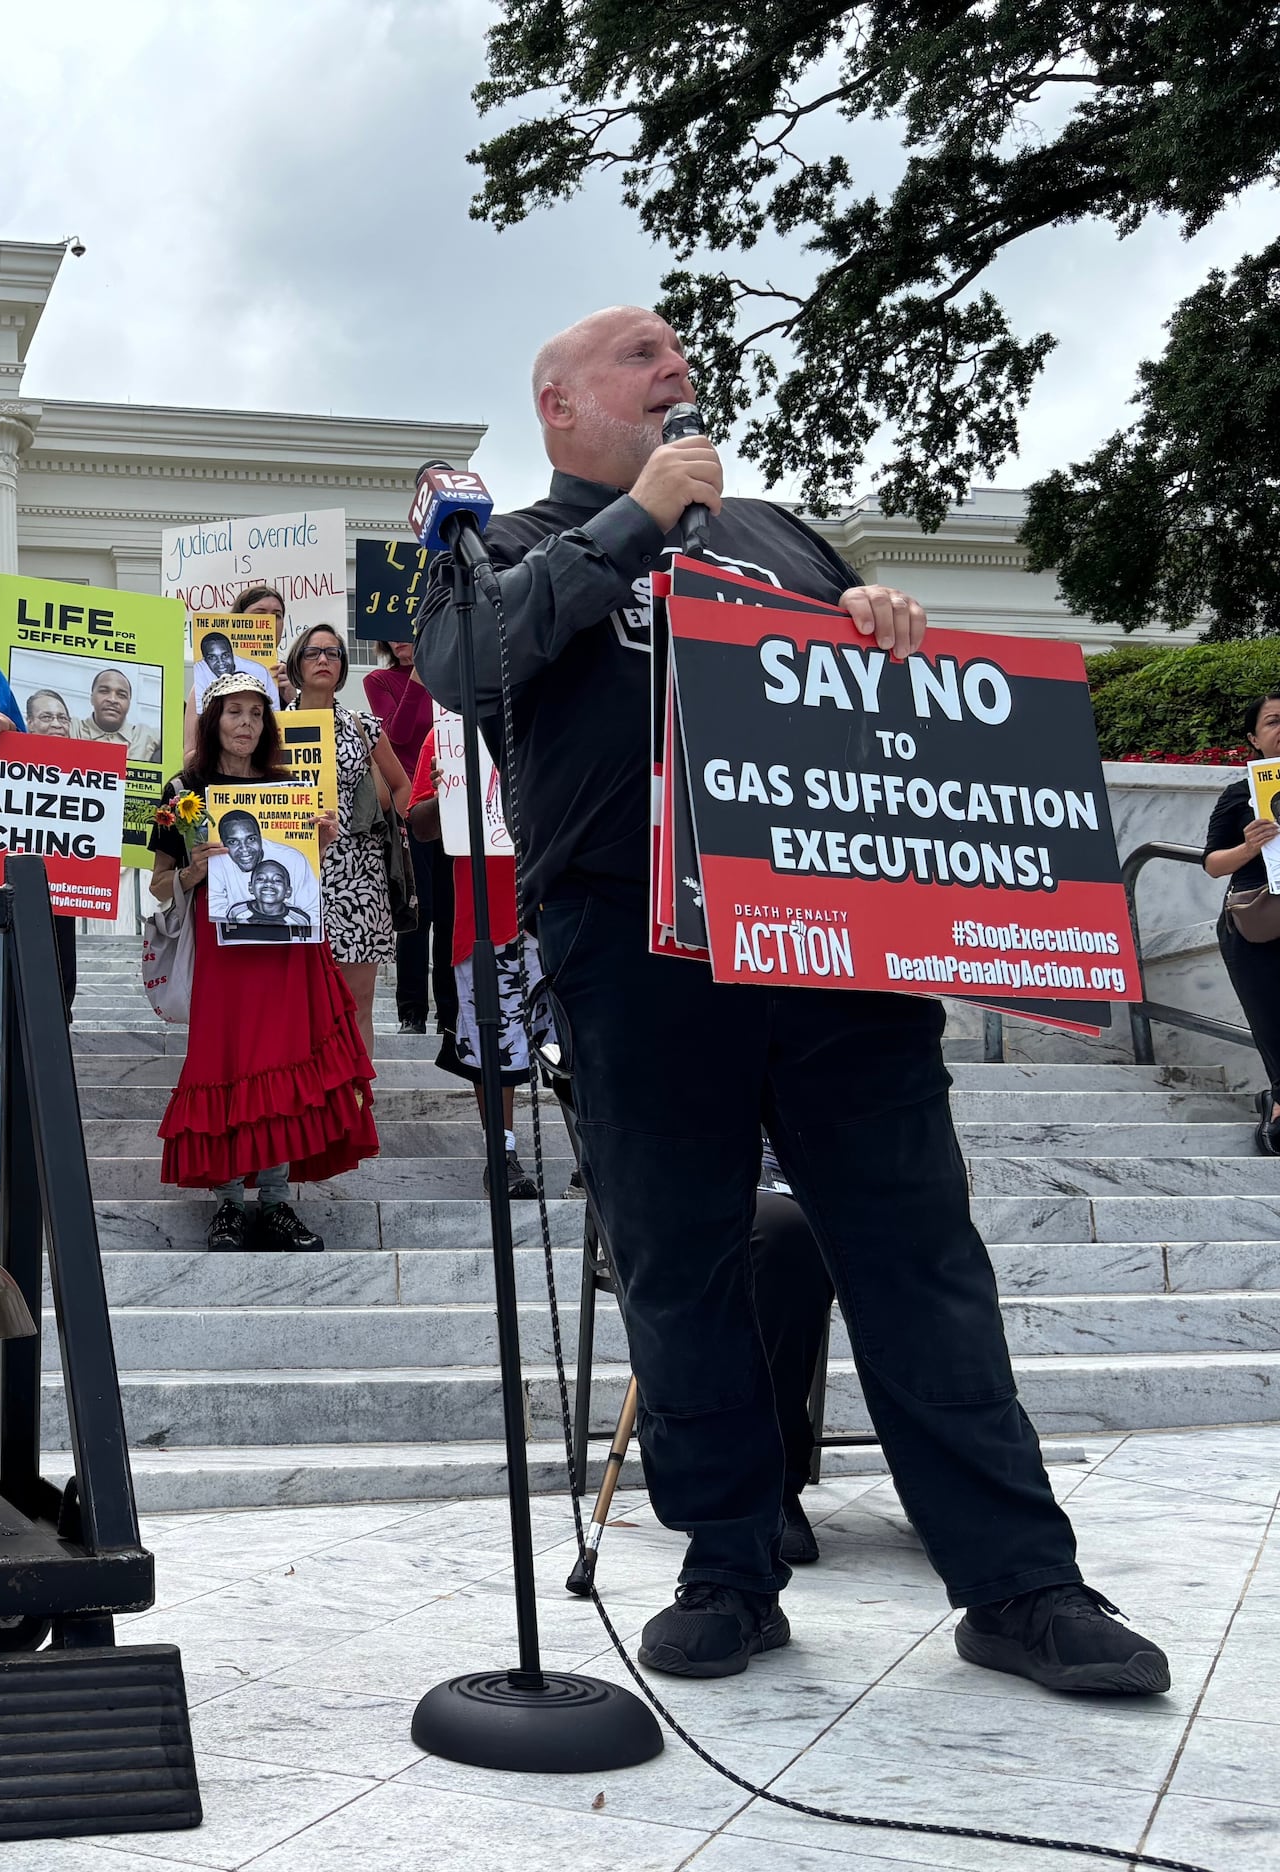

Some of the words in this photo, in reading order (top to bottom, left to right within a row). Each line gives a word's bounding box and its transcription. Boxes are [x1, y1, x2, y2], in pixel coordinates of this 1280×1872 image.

[435, 473, 482, 491] 12
[412, 481, 433, 525] 12
[441, 490, 489, 501] WSFA
[419, 499, 438, 540] WSFA
[166, 521, 233, 582] judicial
[248, 513, 319, 550] override
[17, 598, 114, 637] LIFE
[115, 631, 136, 640] FOR
[196, 618, 209, 628] THE
[211, 618, 230, 629] JURY
[231, 619, 254, 629] VOTED
[255, 619, 272, 630] LIFE.
[17, 628, 98, 650] JEFFERY
[104, 640, 137, 655] LEE
[230, 633, 256, 641] ALABAMA
[251, 649, 274, 657] ANYWAY.
[759, 639, 886, 713] SAY
[908, 655, 1013, 726] NO
[294, 747, 322, 764] FOR
[875, 730, 916, 761] TO
[66, 769, 118, 791] ARE
[1257, 770, 1273, 782] THE
[126, 782, 156, 792] THEM.
[703, 758, 794, 807] GAS
[803, 768, 1099, 832] SUFFOCATION
[213, 793, 230, 804] THE
[232, 793, 257, 805] JURY
[259, 793, 289, 805] VOTED
[291, 794, 313, 806] LIFE.
[258, 811, 292, 820] ALABAMA
[293, 812, 315, 820] PLANS
[260, 822, 269, 830] TO
[270, 821, 300, 830] EXECUTE
[301, 821, 315, 830] HIM
[284, 831, 316, 841] ANYWAY.
[770, 826, 1054, 888] EXECUTIONS!
[734, 904, 780, 920] DEATH
[785, 907, 848, 923] PENALTY
[952, 921, 1120, 955] #StopExecutions
[734, 921, 855, 978] ACTION
[885, 953, 1126, 993] DeathPenaltyAction.org
